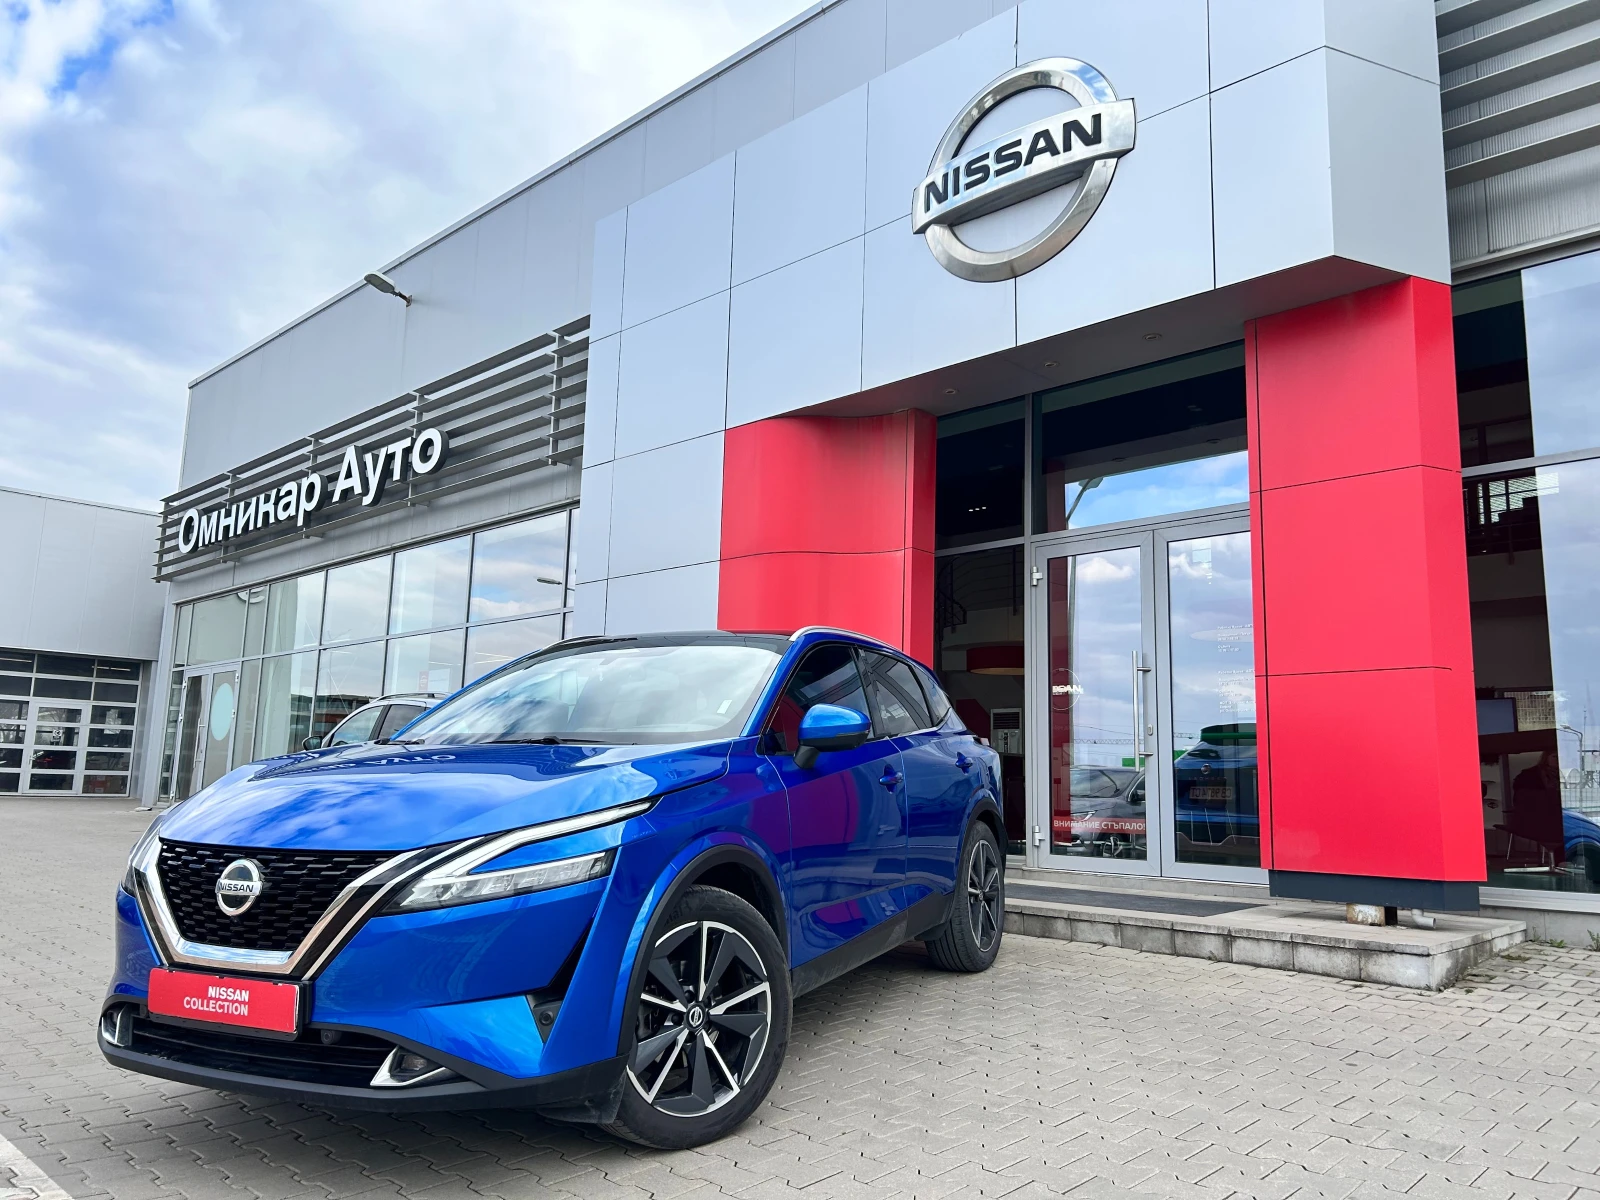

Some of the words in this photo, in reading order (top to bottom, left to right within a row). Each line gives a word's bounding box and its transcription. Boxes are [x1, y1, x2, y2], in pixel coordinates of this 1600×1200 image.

[924, 113, 1102, 214] NISSAN
[178, 473, 322, 554] Омникар
[332, 428, 443, 506] Ауто
[1053, 819, 1100, 829] ВНИМАНИЕ
[218, 881, 254, 893] NISSAN
[208, 985, 250, 1003] NISSAN
[183, 996, 249, 1017] COLLECTION
